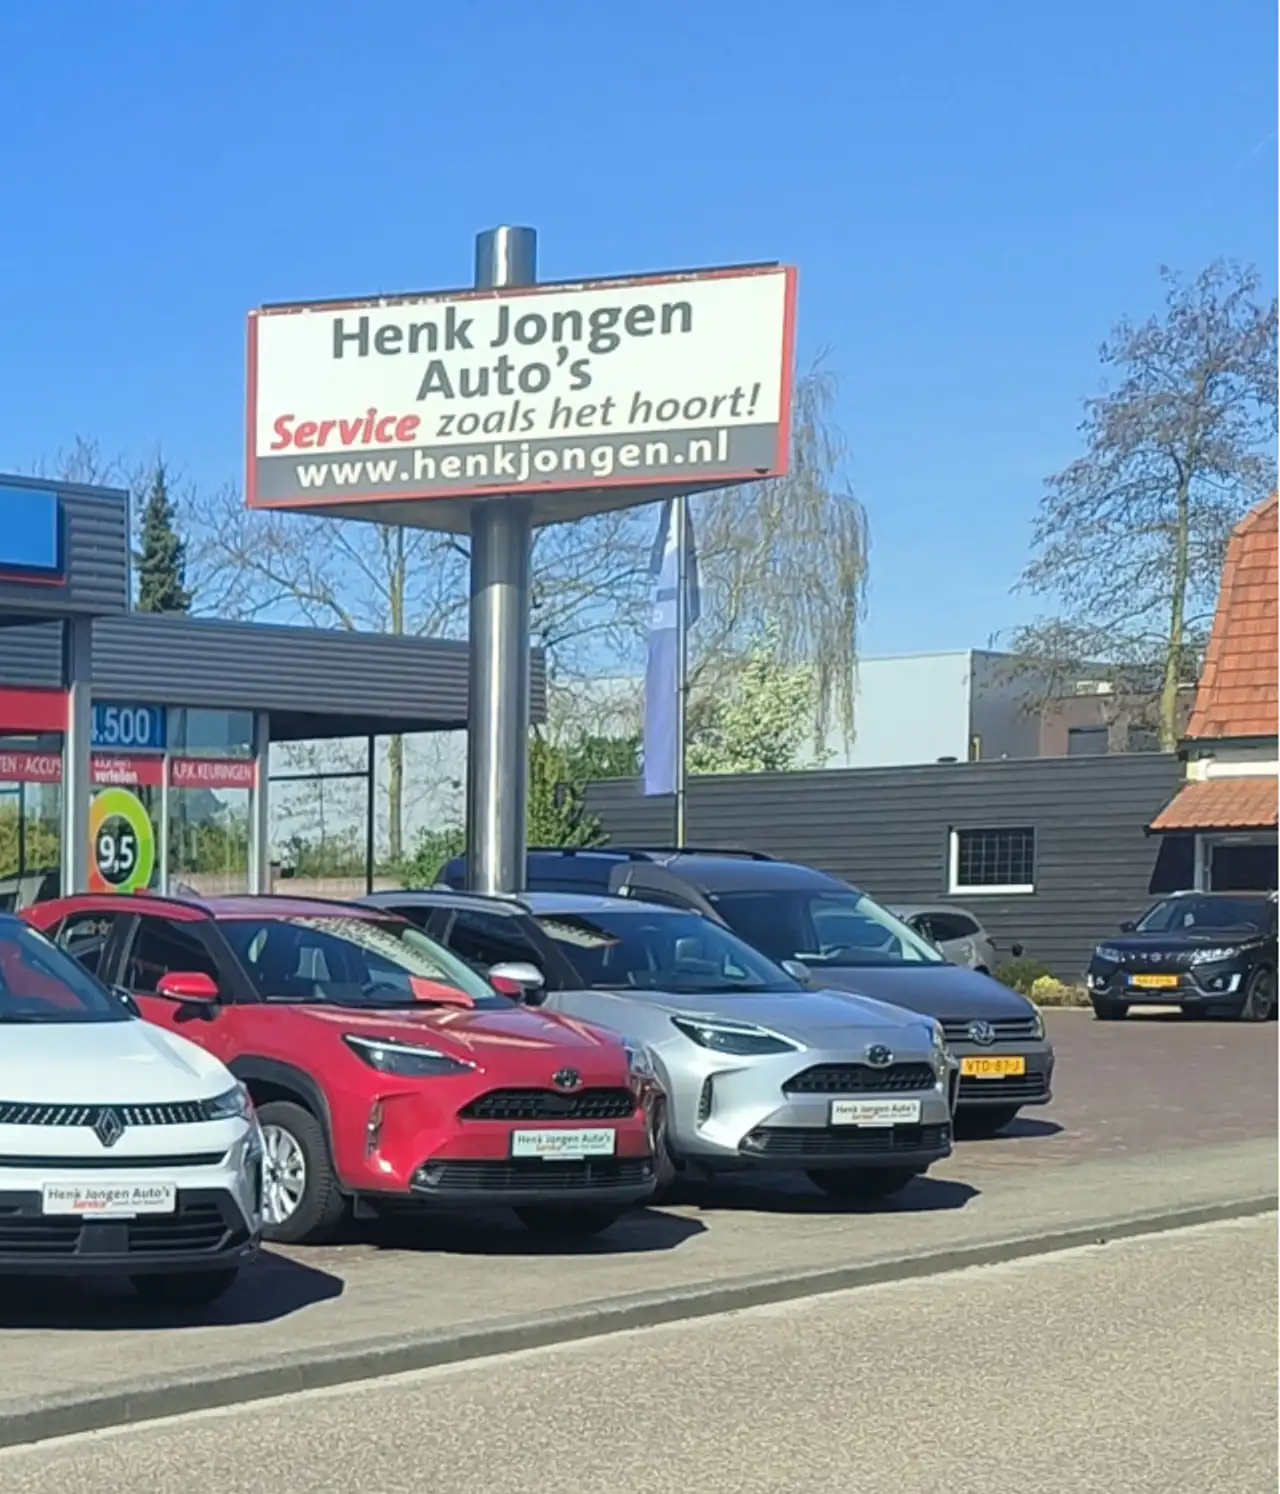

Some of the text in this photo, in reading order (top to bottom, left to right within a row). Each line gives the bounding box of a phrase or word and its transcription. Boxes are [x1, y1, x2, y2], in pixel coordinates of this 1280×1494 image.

[333, 300, 693, 359] Henk Jongen
[270, 382, 761, 449] Service zoals het hoort!
[297, 430, 728, 488] www.henkjongen.nl
[99, 835, 134, 873] 9,5
[47, 1188, 81, 1200] Henk
[85, 1188, 130, 1201] Jongen
